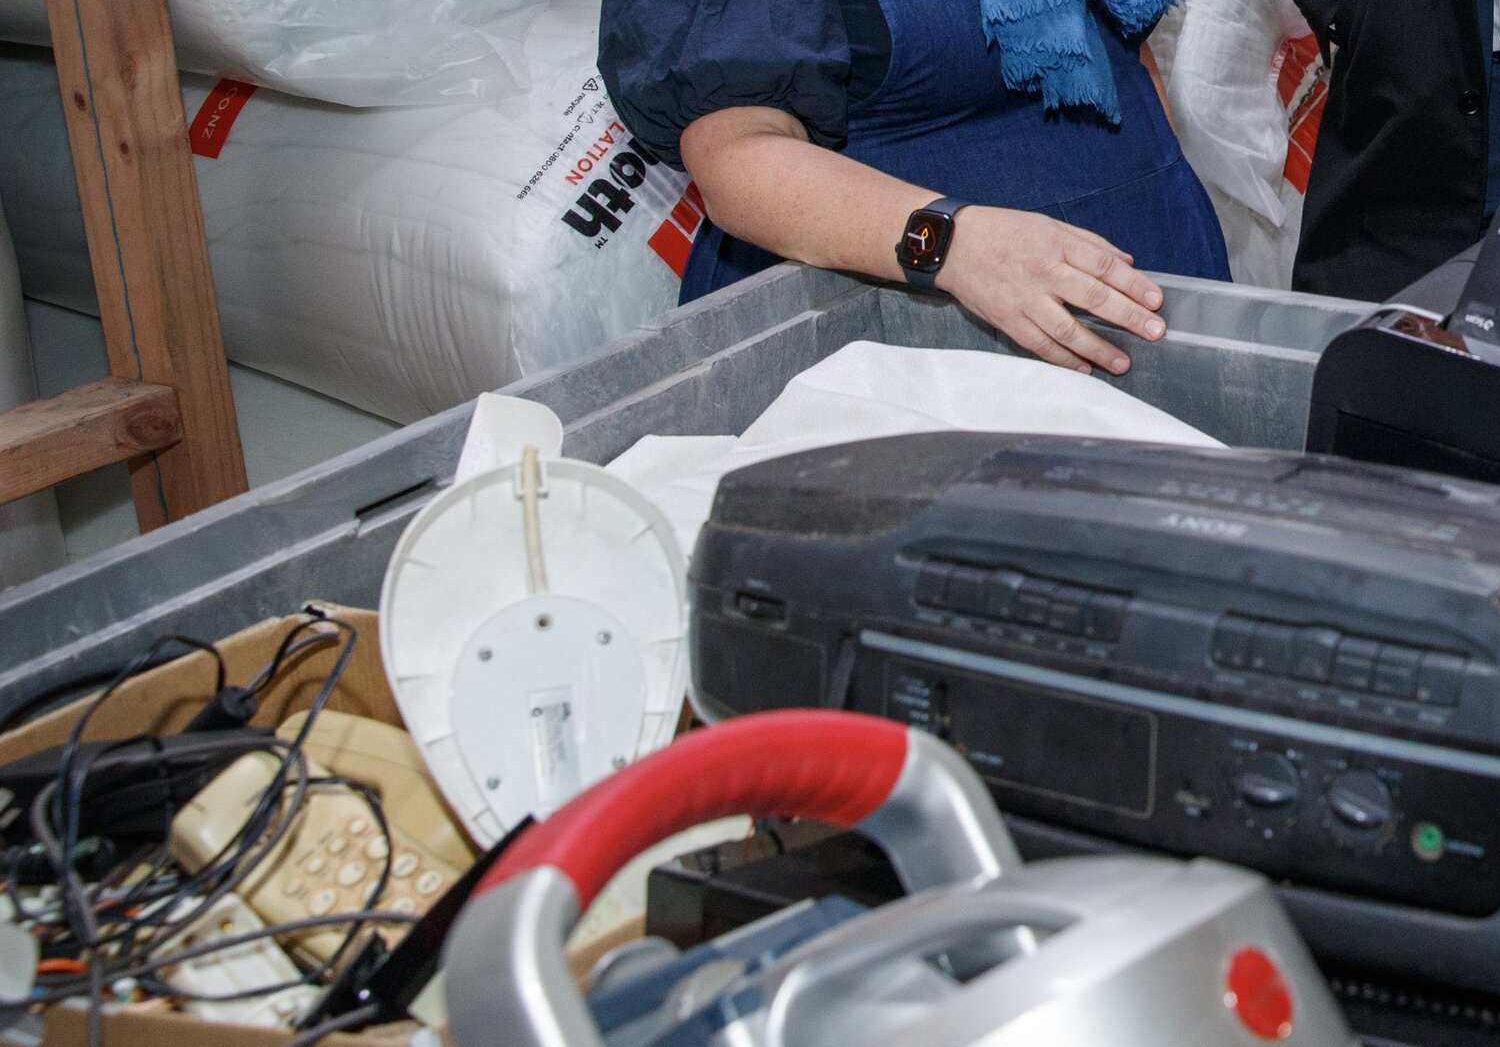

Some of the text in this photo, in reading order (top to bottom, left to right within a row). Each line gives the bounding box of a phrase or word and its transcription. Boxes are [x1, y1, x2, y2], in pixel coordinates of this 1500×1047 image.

[562, 91, 586, 117] recycle
[540, 150, 559, 171] 0800
[528, 170, 543, 185] 626
[516, 184, 531, 200] 668
[593, 235, 608, 249] TM
